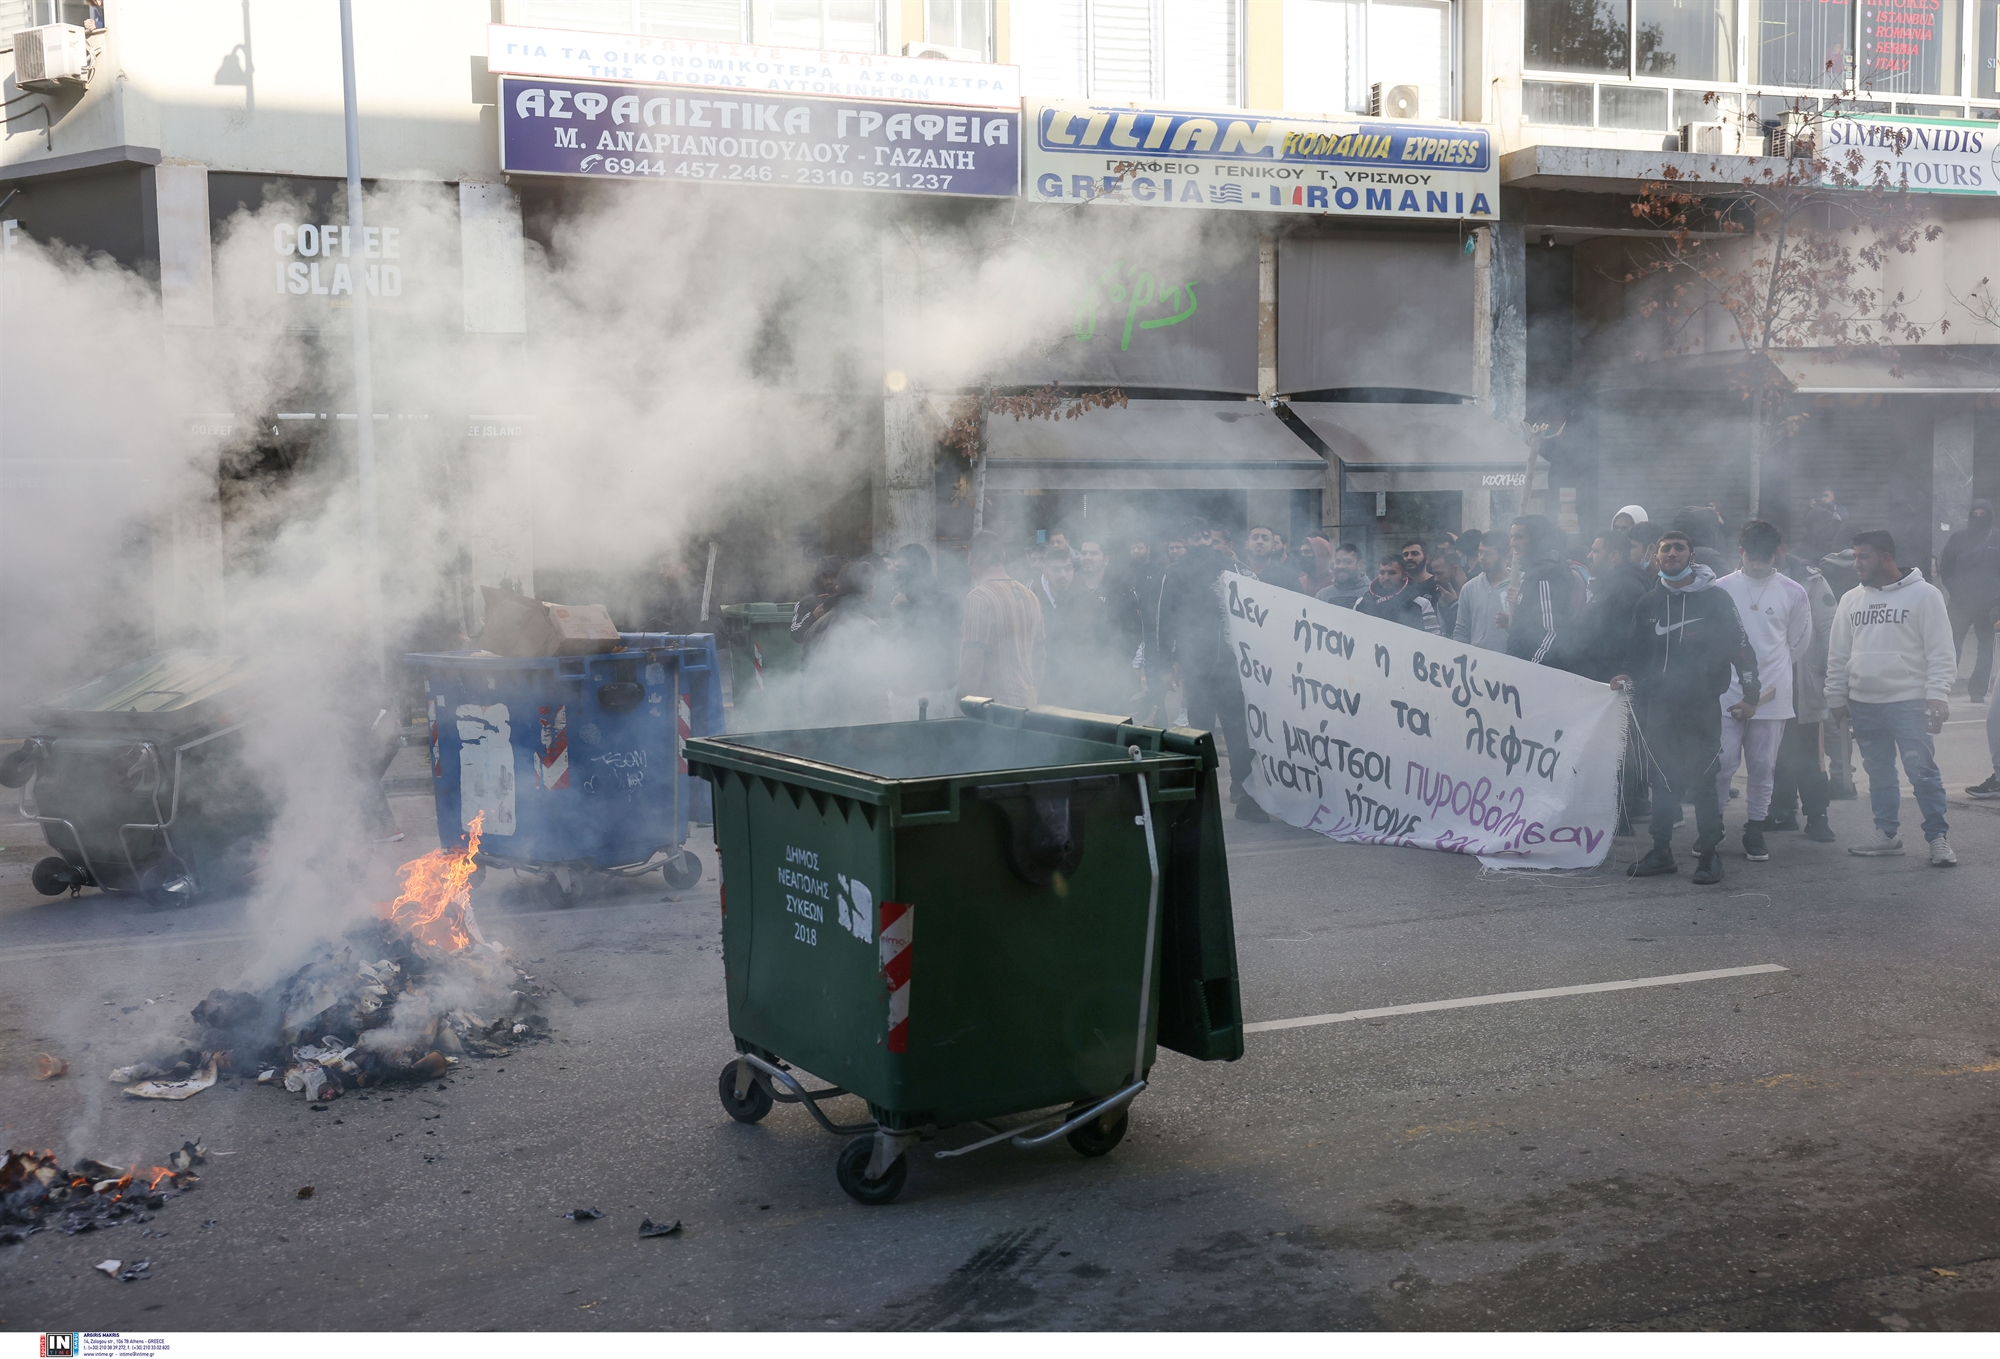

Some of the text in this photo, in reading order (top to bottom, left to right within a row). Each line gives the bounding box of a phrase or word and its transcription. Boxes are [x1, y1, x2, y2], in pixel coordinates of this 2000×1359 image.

[1875, 11, 1935, 26] ISTANBUL
[1875, 26, 1933, 41] ROMANIA
[639, 37, 874, 67] ΡΩΤΗΣΤΕ ΕΔΩ
[1875, 41, 1919, 56] SERBIA
[1875, 57, 1909, 71] ITALY
[507, 43, 1004, 91] ΓΙΑ ΤΑ ΟΙΚΟΝΟΜΙΚΟΤΕΡΑ ΑΣΦΑΛΙΣΤΡΑ
[588, 65, 930, 100] ΤΗΣ ΑΓΟΡΑΣ ΑΥΤΟΚΙΝΗΤΩΝ
[516, 88, 1010, 147] ΑΣΦΑΛΙΣΤΙΚΑ ΓΡΑΦΕΙΑ
[554, 127, 587, 149] Μ.
[596, 129, 850, 164] ΑΝΔΡΙΑΝΟΠΟΥΛΟΥ
[874, 146, 976, 170] ΓΑΖΑΝΗ
[1046, 110, 1479, 165] LILIAN ROMANIA EXPRESS
[1829, 122, 1984, 154] SIMEONIDIS
[604, 157, 667, 175] 6944
[674, 161, 773, 181] 457.246
[796, 167, 853, 185] 2310
[862, 171, 953, 190] 521.237
[1106, 159, 1200, 175] ΓΡΑΦΕΙΟ
[1214, 164, 1304, 180] ΓΕΝΙΚΟΥ
[1896, 161, 1983, 187] TOURS
[1037, 172, 1204, 204] GRECIA
[1307, 185, 1492, 215] ROMANIA
[276, 261, 402, 297] ISLAND
[1228, 580, 1270, 628] Δεν
[1293, 607, 1356, 661] ήταν
[1374, 643, 1391, 678] η
[1850, 608, 1910, 627] YOURSELF
[1238, 641, 1564, 783] δεν ήταν τα λεφτά
[1282, 719, 1392, 790] μπάτσοι
[786, 845, 820, 871] ΔΗΜΟΣ
[778, 867, 830, 900] ΝΕΑΠΟΛΗΣ
[786, 894, 824, 924] ΣΥΚΕΩΝ
[794, 922, 817, 946] 2018
